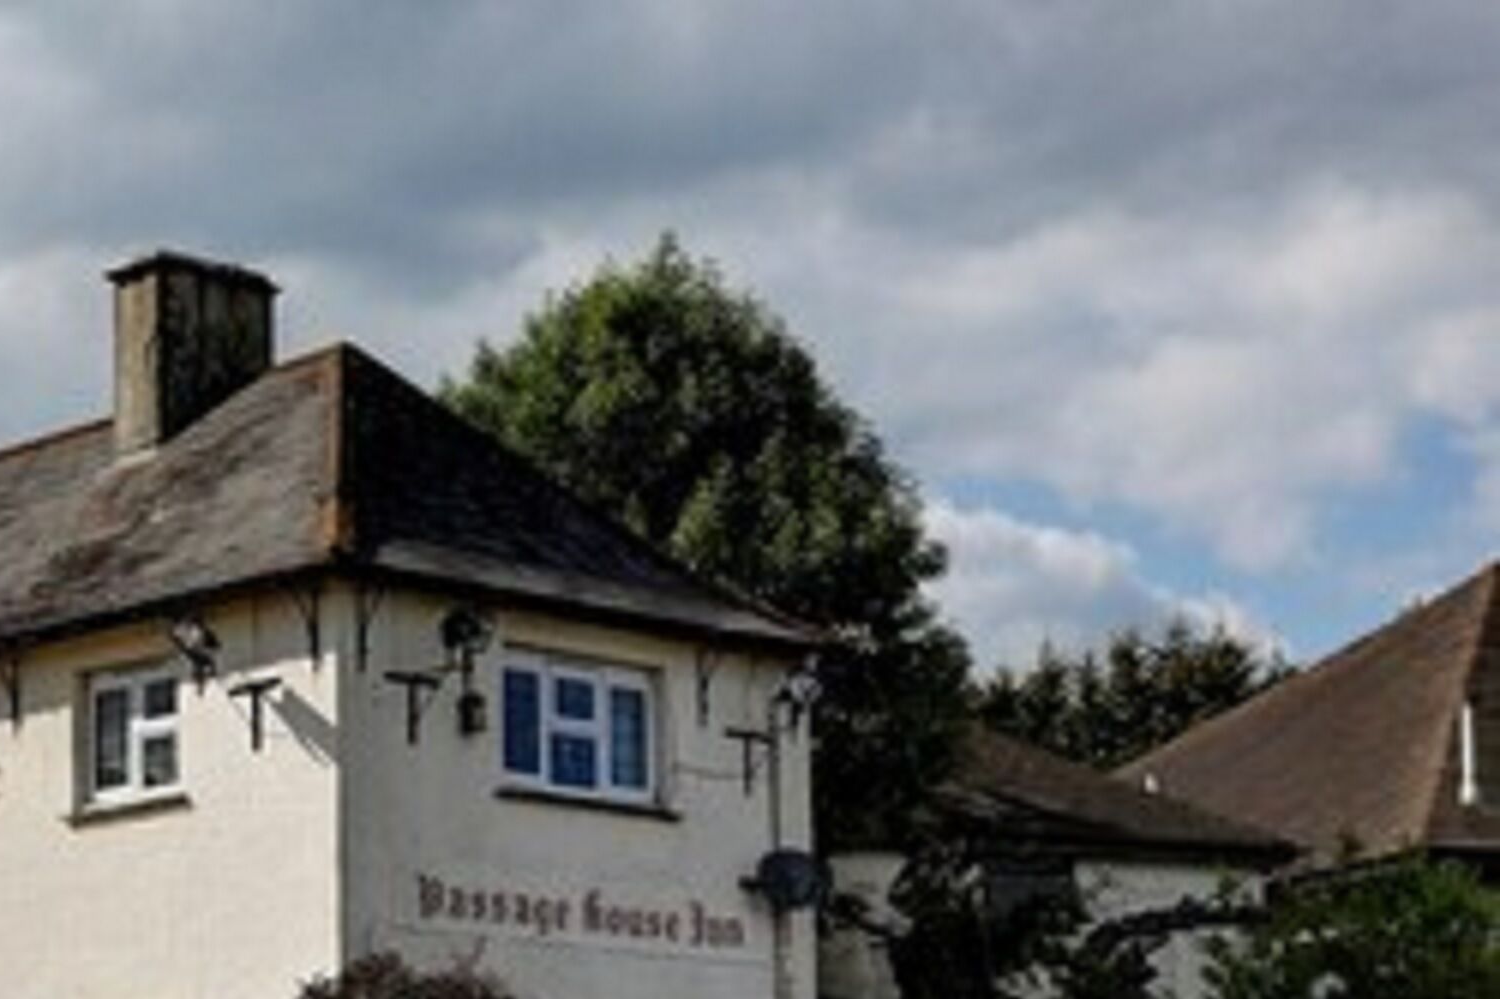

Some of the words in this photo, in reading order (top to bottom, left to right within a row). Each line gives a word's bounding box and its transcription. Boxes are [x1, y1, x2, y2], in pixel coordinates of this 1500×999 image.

[417, 873, 570, 936] Passage
[581, 887, 680, 944] House
[688, 900, 745, 948] Inn
